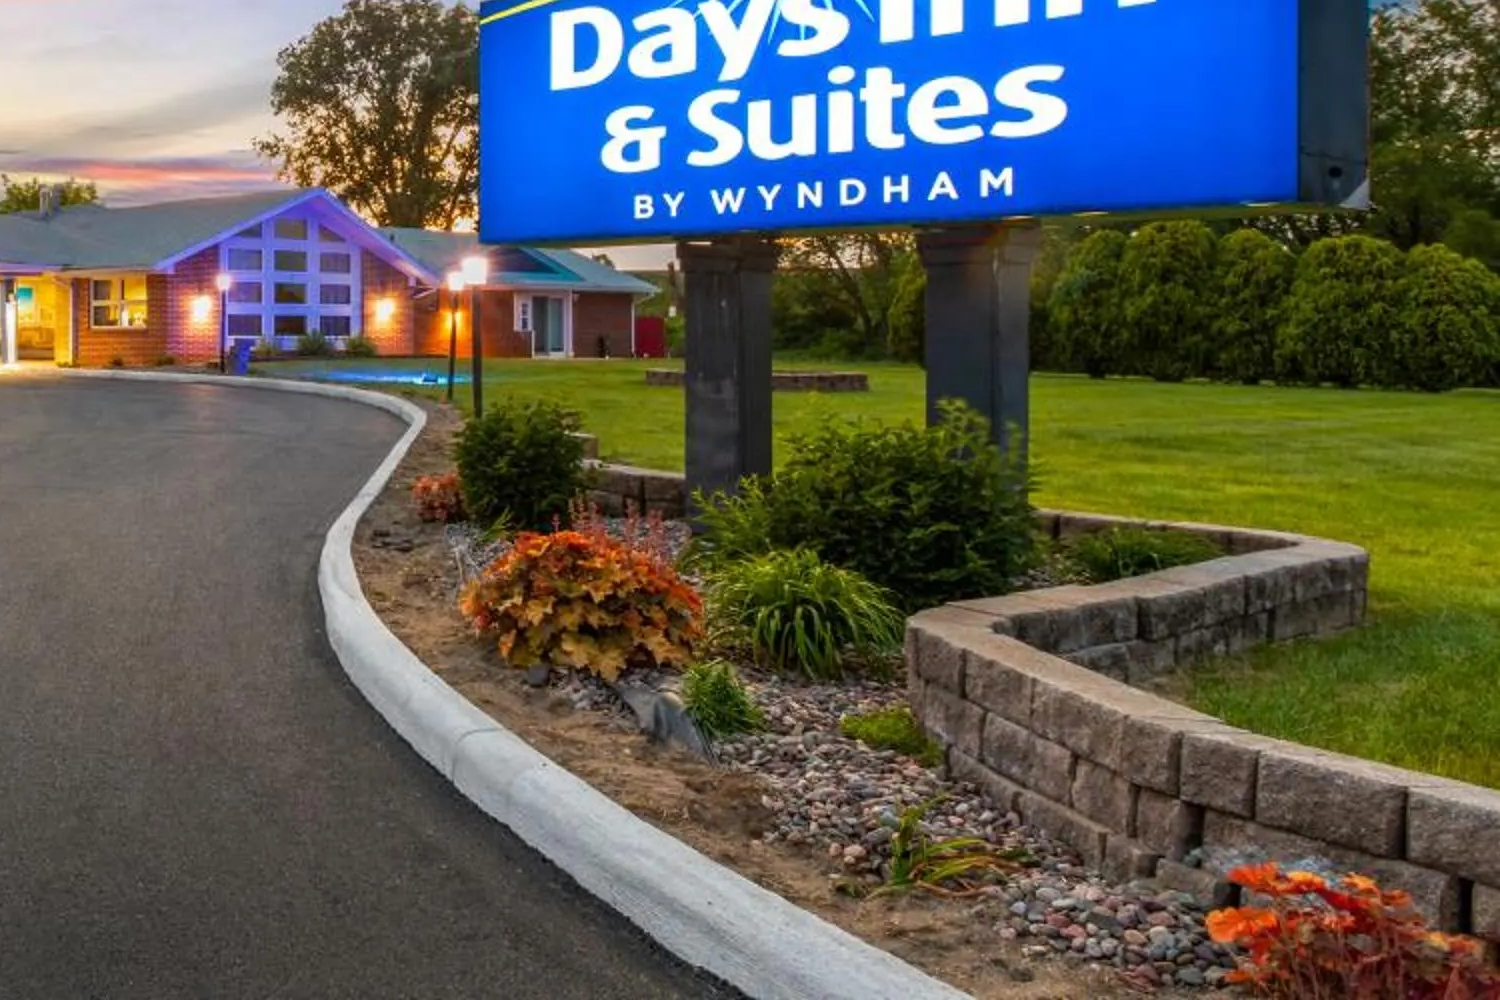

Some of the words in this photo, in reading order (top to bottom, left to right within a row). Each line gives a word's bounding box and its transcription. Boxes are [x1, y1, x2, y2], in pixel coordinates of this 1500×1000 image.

[601, 105, 666, 173] &
[687, 65, 1068, 167] Suites
[633, 192, 685, 220] BY
[711, 167, 1014, 216] WYNDHAM
